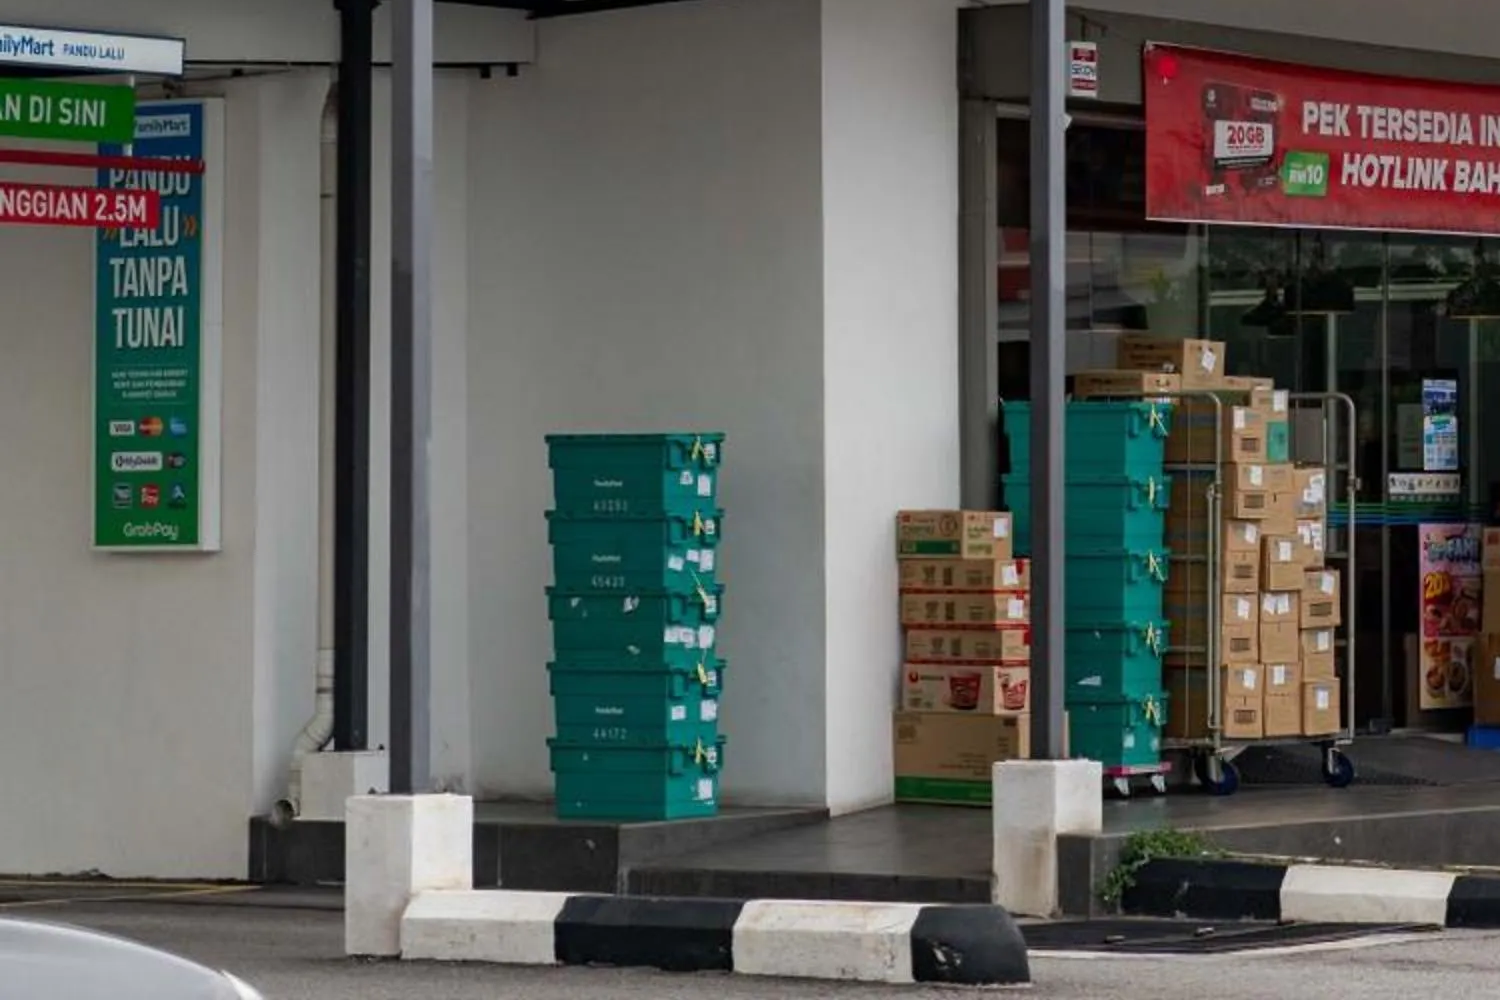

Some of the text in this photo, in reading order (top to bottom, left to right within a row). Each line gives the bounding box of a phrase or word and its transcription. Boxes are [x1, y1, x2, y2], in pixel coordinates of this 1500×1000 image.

[63, 43, 97, 58] PANDU
[99, 47, 125, 61] LALU
[29, 95, 51, 124] DI
[58, 98, 107, 128] SINI
[1302, 100, 1351, 137] PEK
[1357, 104, 1474, 146] TERSEDIA
[1226, 124, 1265, 145] 20GB
[1341, 152, 1449, 192] HOTLINK
[95, 194, 147, 224] 2.5M
[109, 255, 188, 298] TANPA
[112, 305, 185, 349] TUNAI
[123, 521, 180, 541] GrabPay
